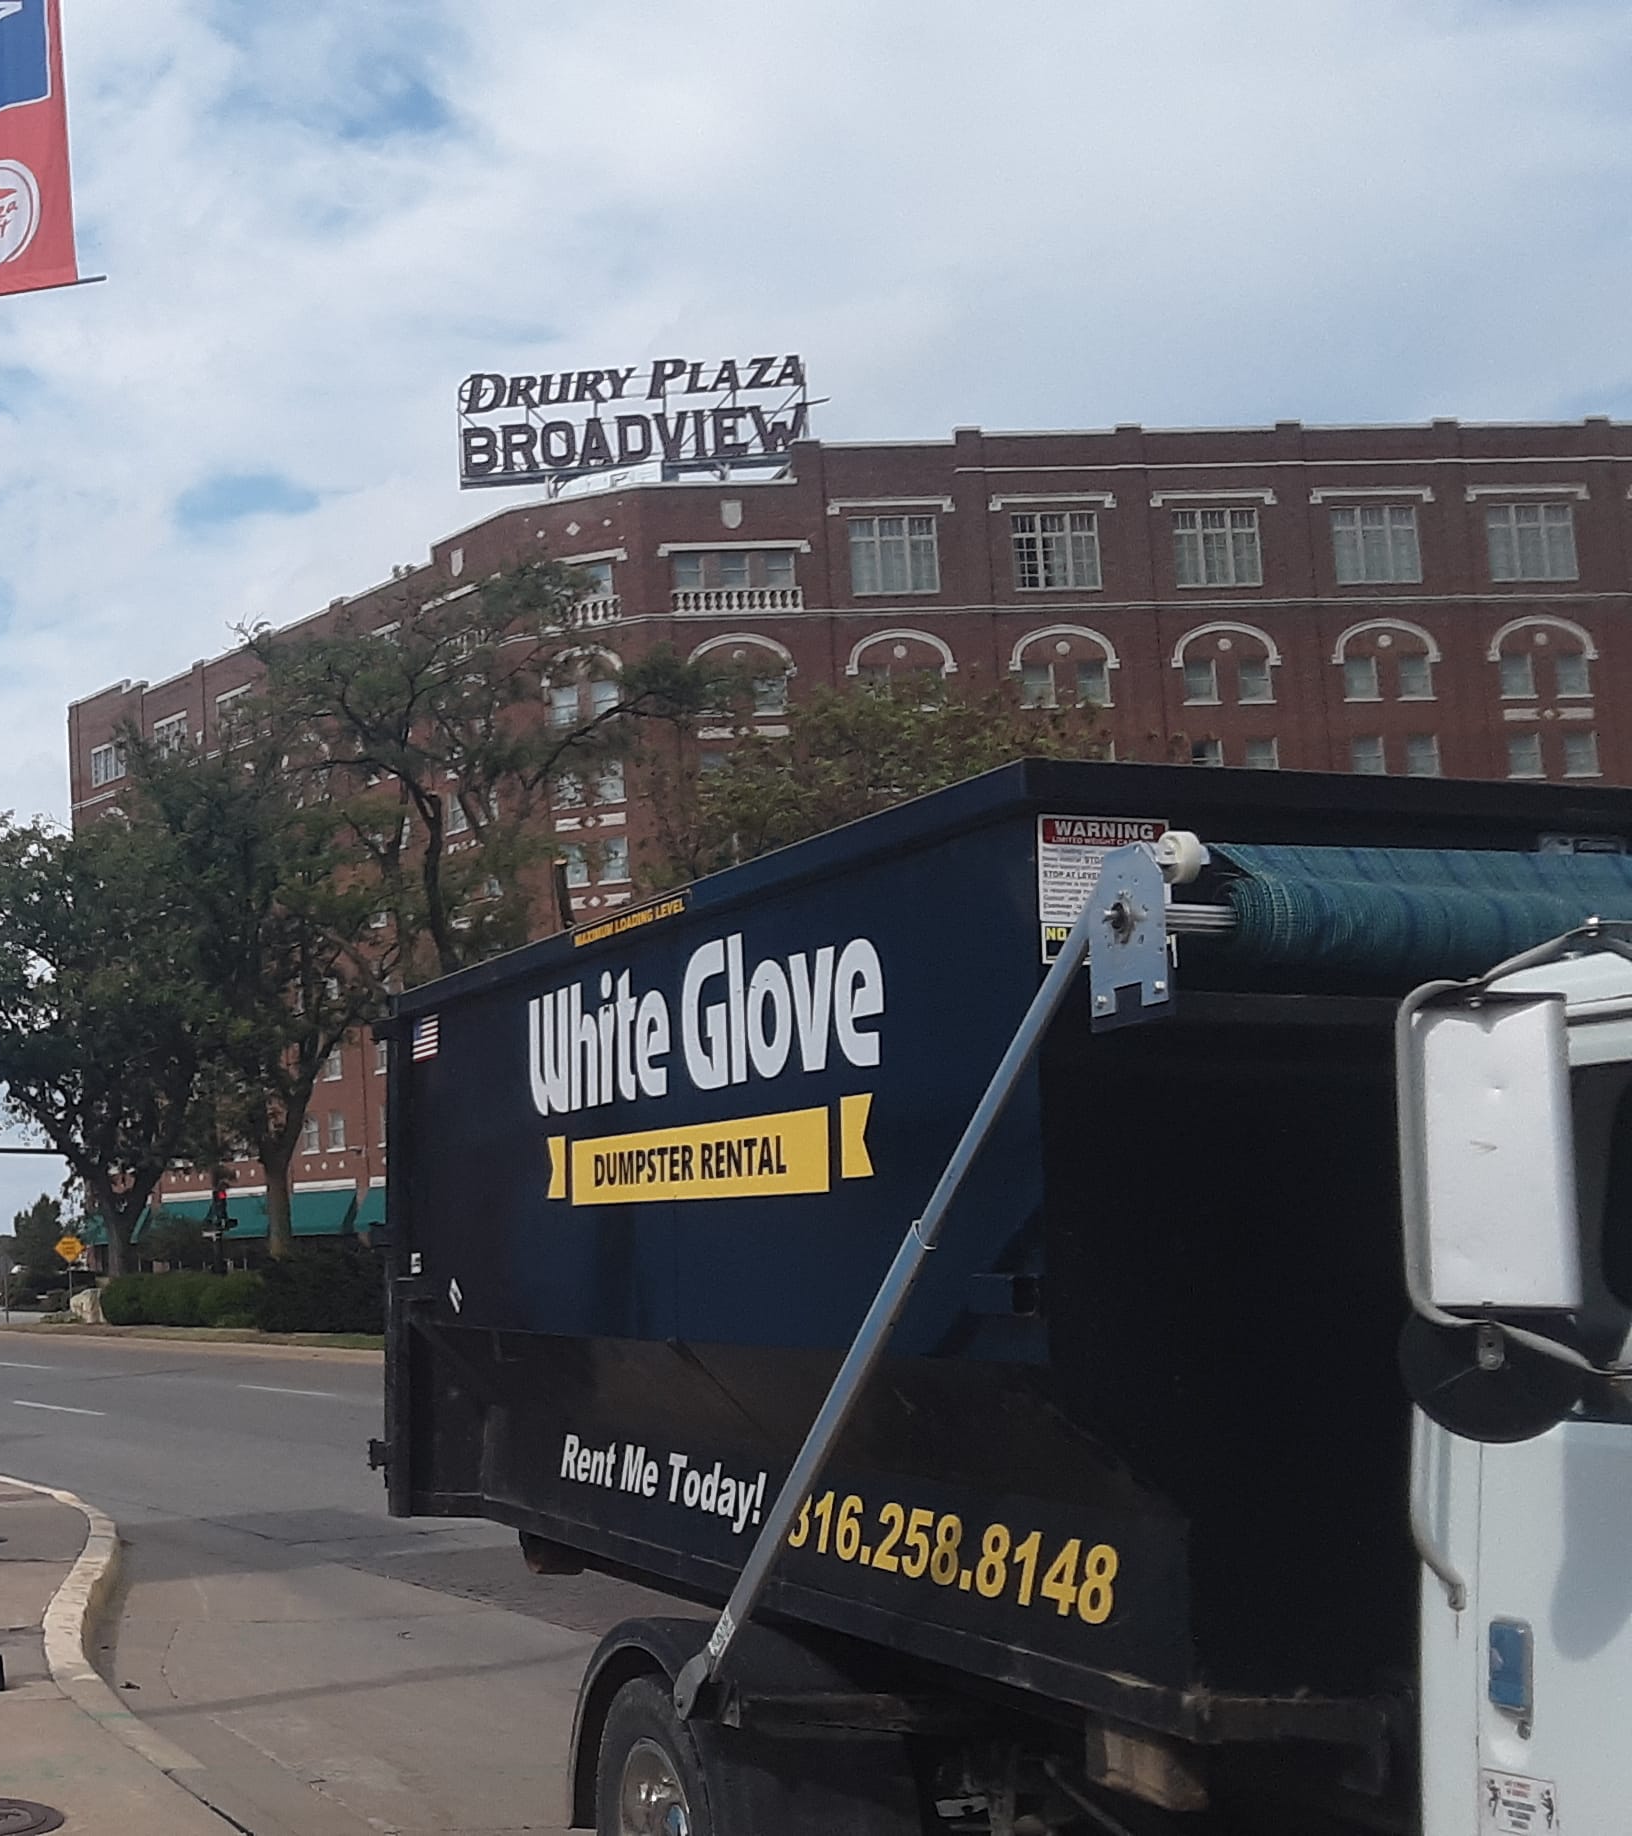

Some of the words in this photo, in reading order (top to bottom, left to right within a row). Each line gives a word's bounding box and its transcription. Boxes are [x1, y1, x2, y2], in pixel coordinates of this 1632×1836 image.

[458, 366, 637, 414] DRURY
[645, 354, 806, 401] PLAZA
[462, 402, 810, 475] BROADVIEW
[1053, 820, 1155, 840] WARNING
[615, 908, 655, 934] LOADING
[655, 897, 686, 921] LEVEL
[528, 967, 670, 1116] White
[680, 932, 885, 1091] Glove
[594, 1146, 694, 1189] DUMPSTER
[700, 1134, 787, 1179] RENTAL
[560, 1433, 617, 1489] Rent
[619, 1443, 659, 1498] Me
[668, 1452, 768, 1535] Today!
